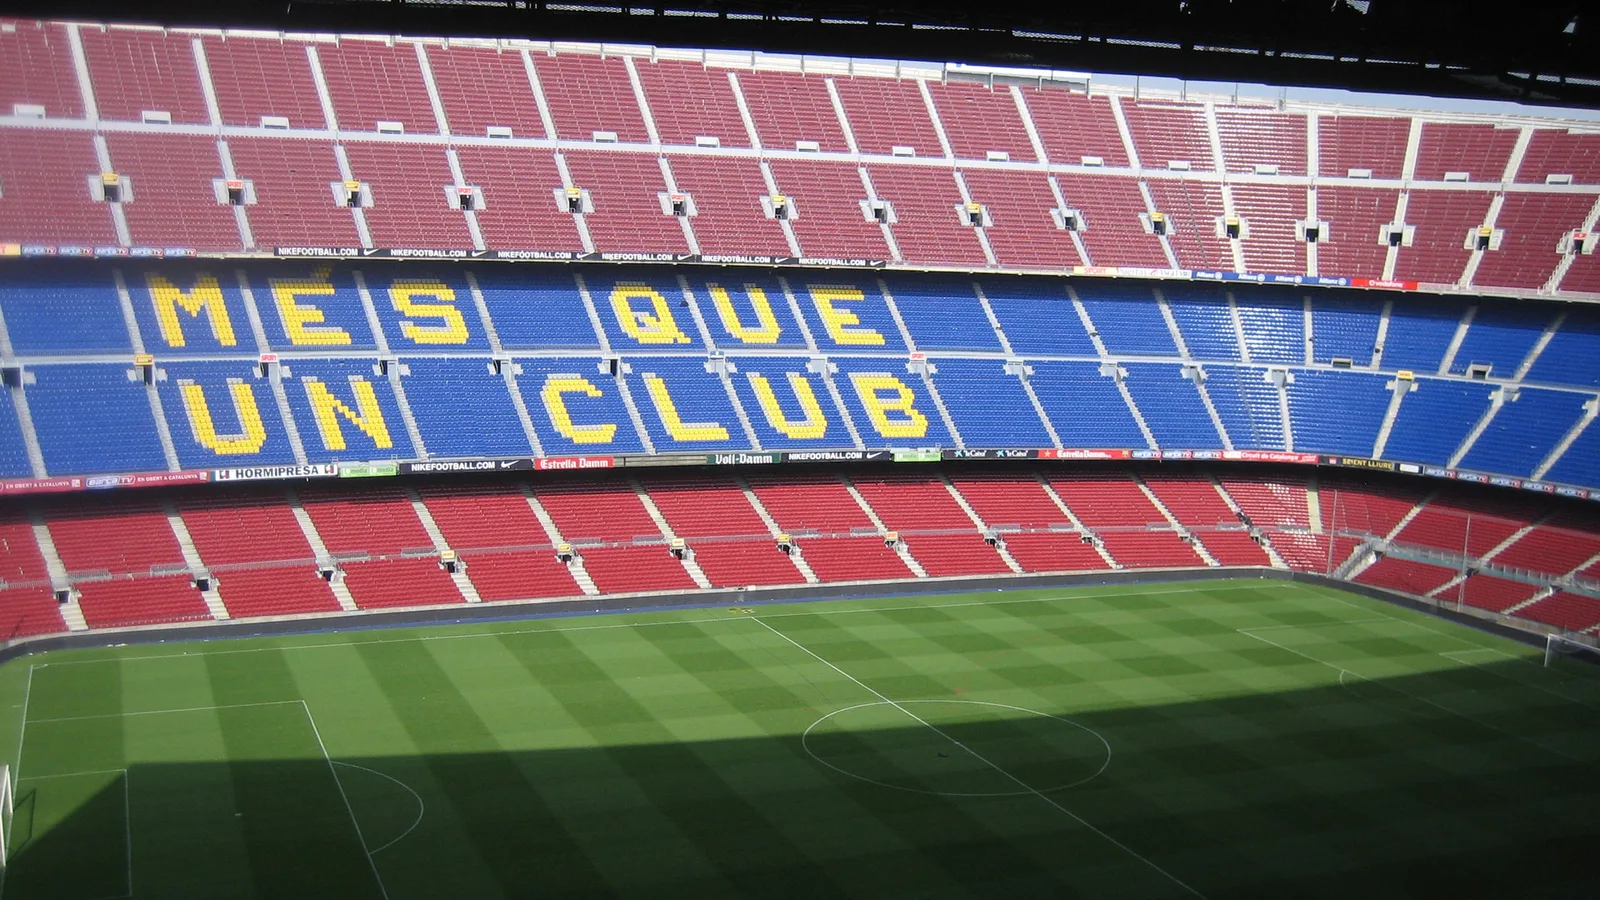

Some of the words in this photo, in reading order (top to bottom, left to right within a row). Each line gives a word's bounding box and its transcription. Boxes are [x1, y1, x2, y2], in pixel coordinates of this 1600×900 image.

[278, 247, 358, 256] NIKEFOOTBALL.COM
[390, 248, 467, 258] NIKEFOOTBALL.COM
[498, 250, 572, 259] NIKEFOOTBALL.COM
[602, 253, 673, 261] NIKEFOOTBALL.COM
[701, 255, 770, 263] NIKEFOOTBALL.COM
[799, 258, 866, 266] NIKEFOOTBALL.COM
[147, 263, 469, 347] MÉS
[609, 281, 885, 345] QUE
[178, 375, 393, 455] UN
[540, 372, 928, 443] CLUB
[715, 453, 772, 465] Voll-Damm
[788, 452, 862, 460] NIKEFOOTBALL.COM
[411, 461, 496, 471] NIKEFOOTBALL.COM
[540, 458, 577, 469] Estrella
[579, 457, 609, 468] Damm
[1367, 460, 1392, 469] LLIURE
[235, 464, 319, 479] HORMIPRESA
